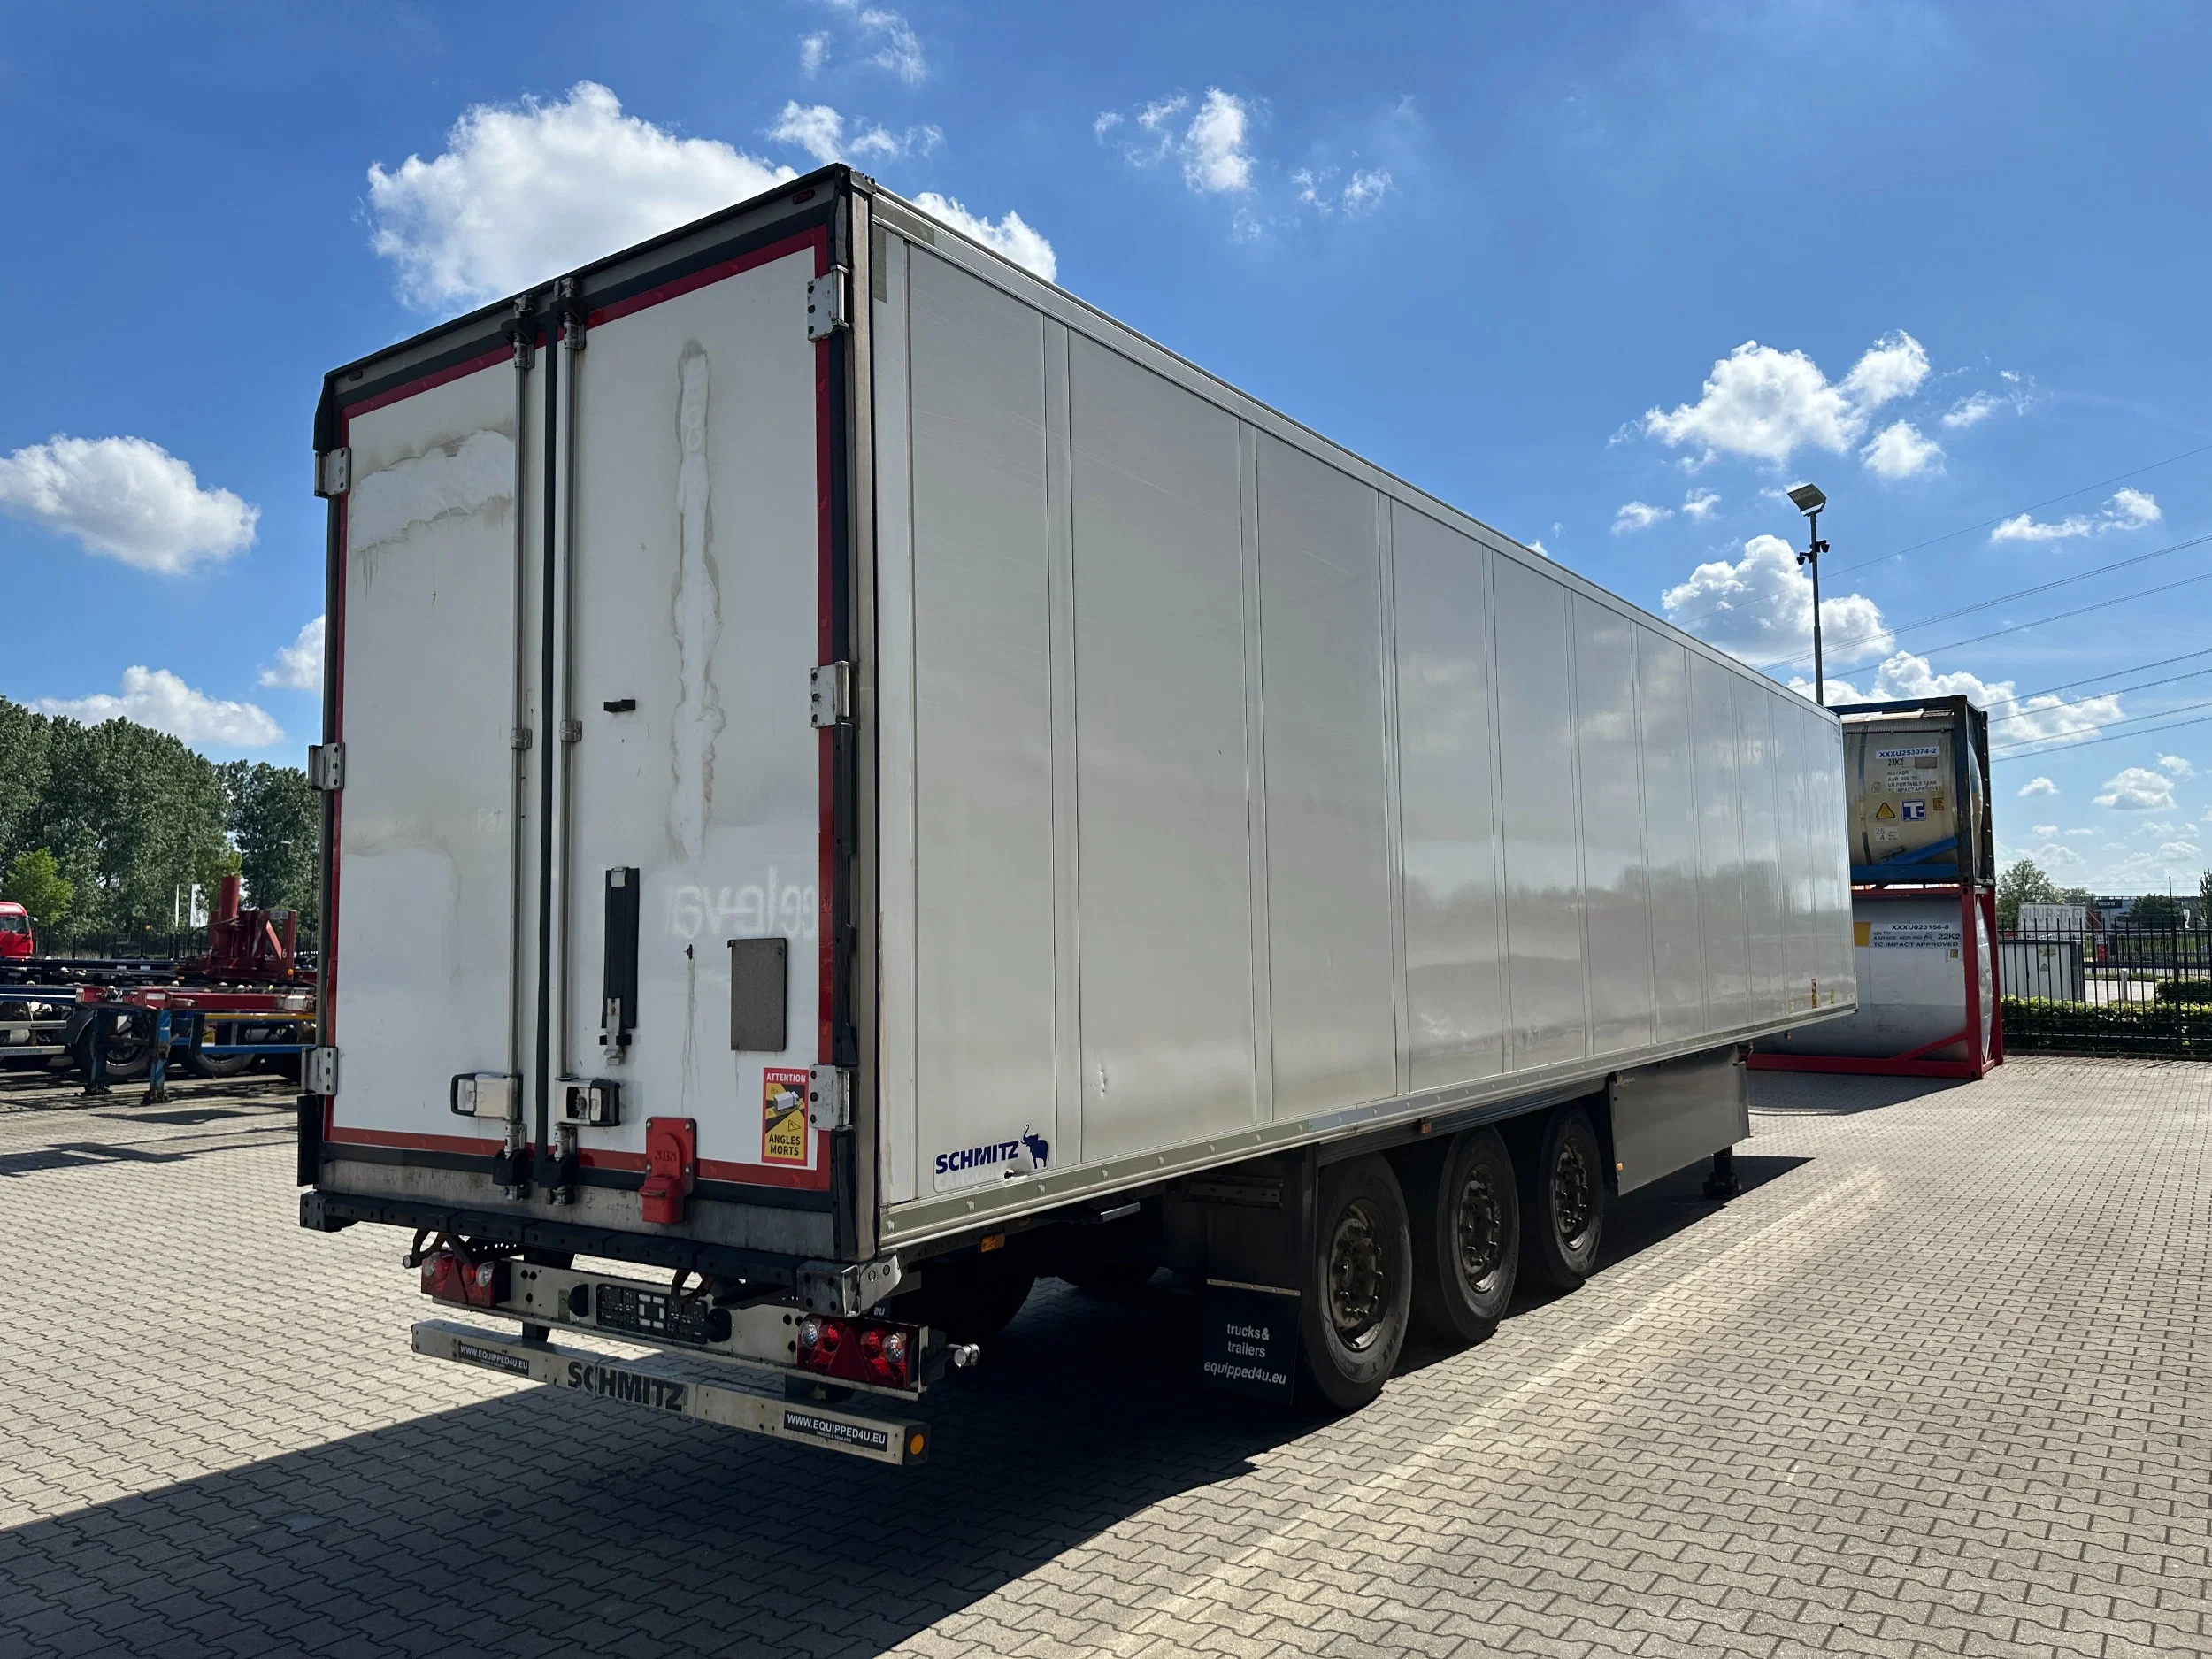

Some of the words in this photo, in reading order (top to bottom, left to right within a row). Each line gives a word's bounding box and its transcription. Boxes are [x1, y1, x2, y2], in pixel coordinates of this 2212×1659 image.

[1879, 748, 1937, 757] XXXU253074-2
[1887, 757, 1903, 766] 22K2
[766, 1072, 806, 1083] ATTENTION
[769, 1134, 801, 1145] ANGLES
[770, 1145, 800, 1156] MORTS
[936, 1140, 1019, 1175] SCHMITZ
[460, 1345, 528, 1370] WWW.EQUIPPED4U.EU
[1227, 1340, 1266, 1358] trailers
[1203, 1361, 1286, 1385] equipped4u.eu
[567, 1361, 685, 1412] SCHMITZ
[787, 1414, 887, 1444] WWW.EQUIPPED4U.EU
